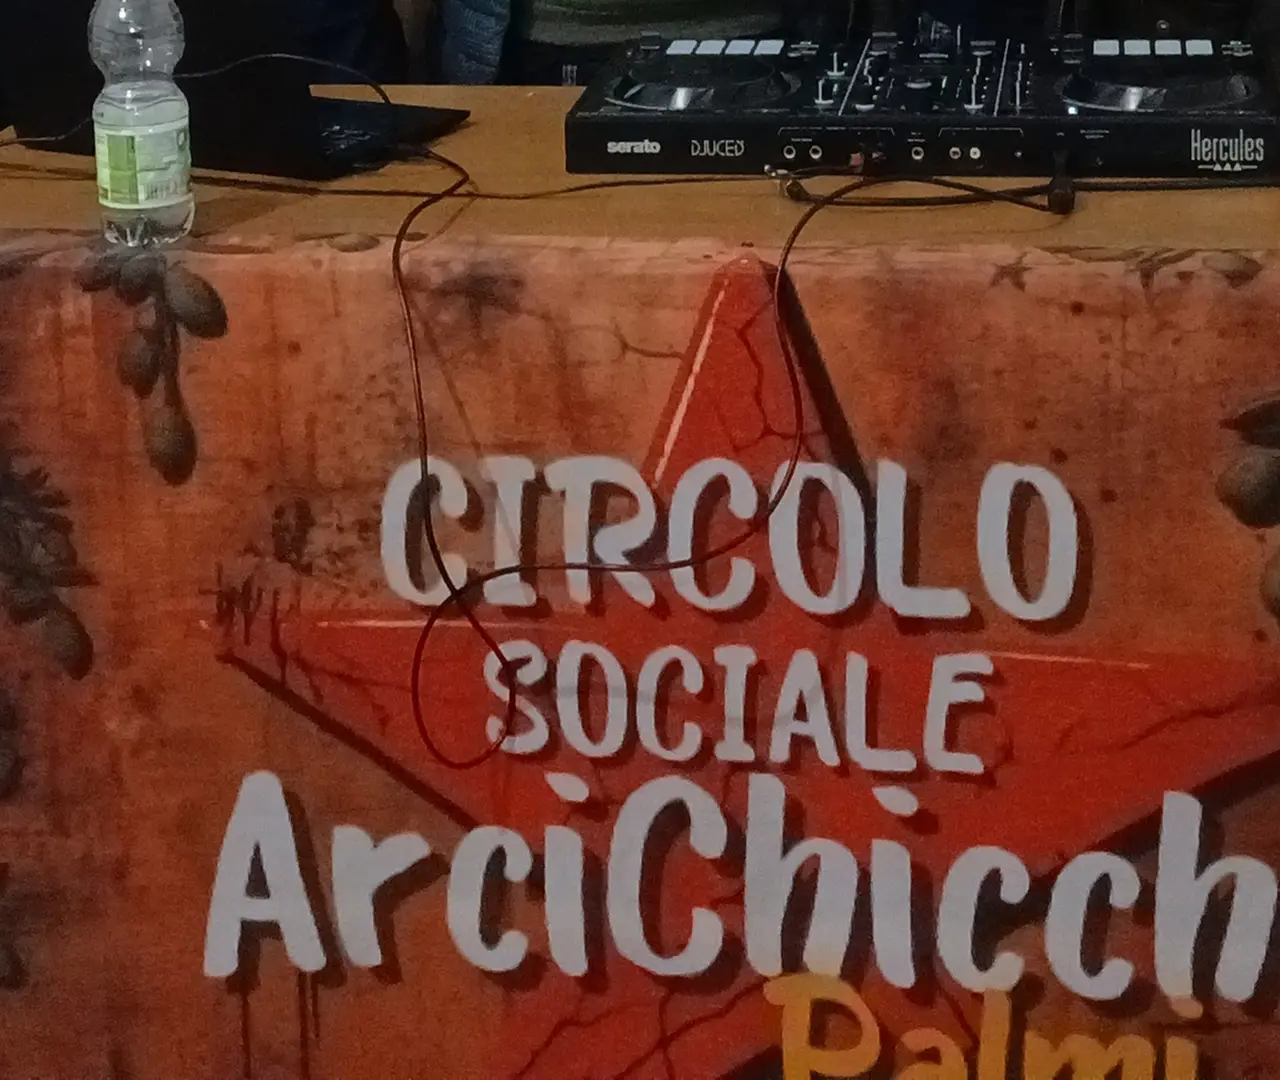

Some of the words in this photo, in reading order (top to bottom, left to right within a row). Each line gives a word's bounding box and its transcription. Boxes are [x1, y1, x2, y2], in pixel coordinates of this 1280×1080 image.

[606, 139, 661, 154] serato
[690, 139, 745, 157] DJUCED
[1190, 128, 1265, 162] Hercules
[379, 456, 1079, 621] CIRCOLO
[483, 641, 993, 773] SOCIALE
[763, 972, 1203, 1080] Palmi
